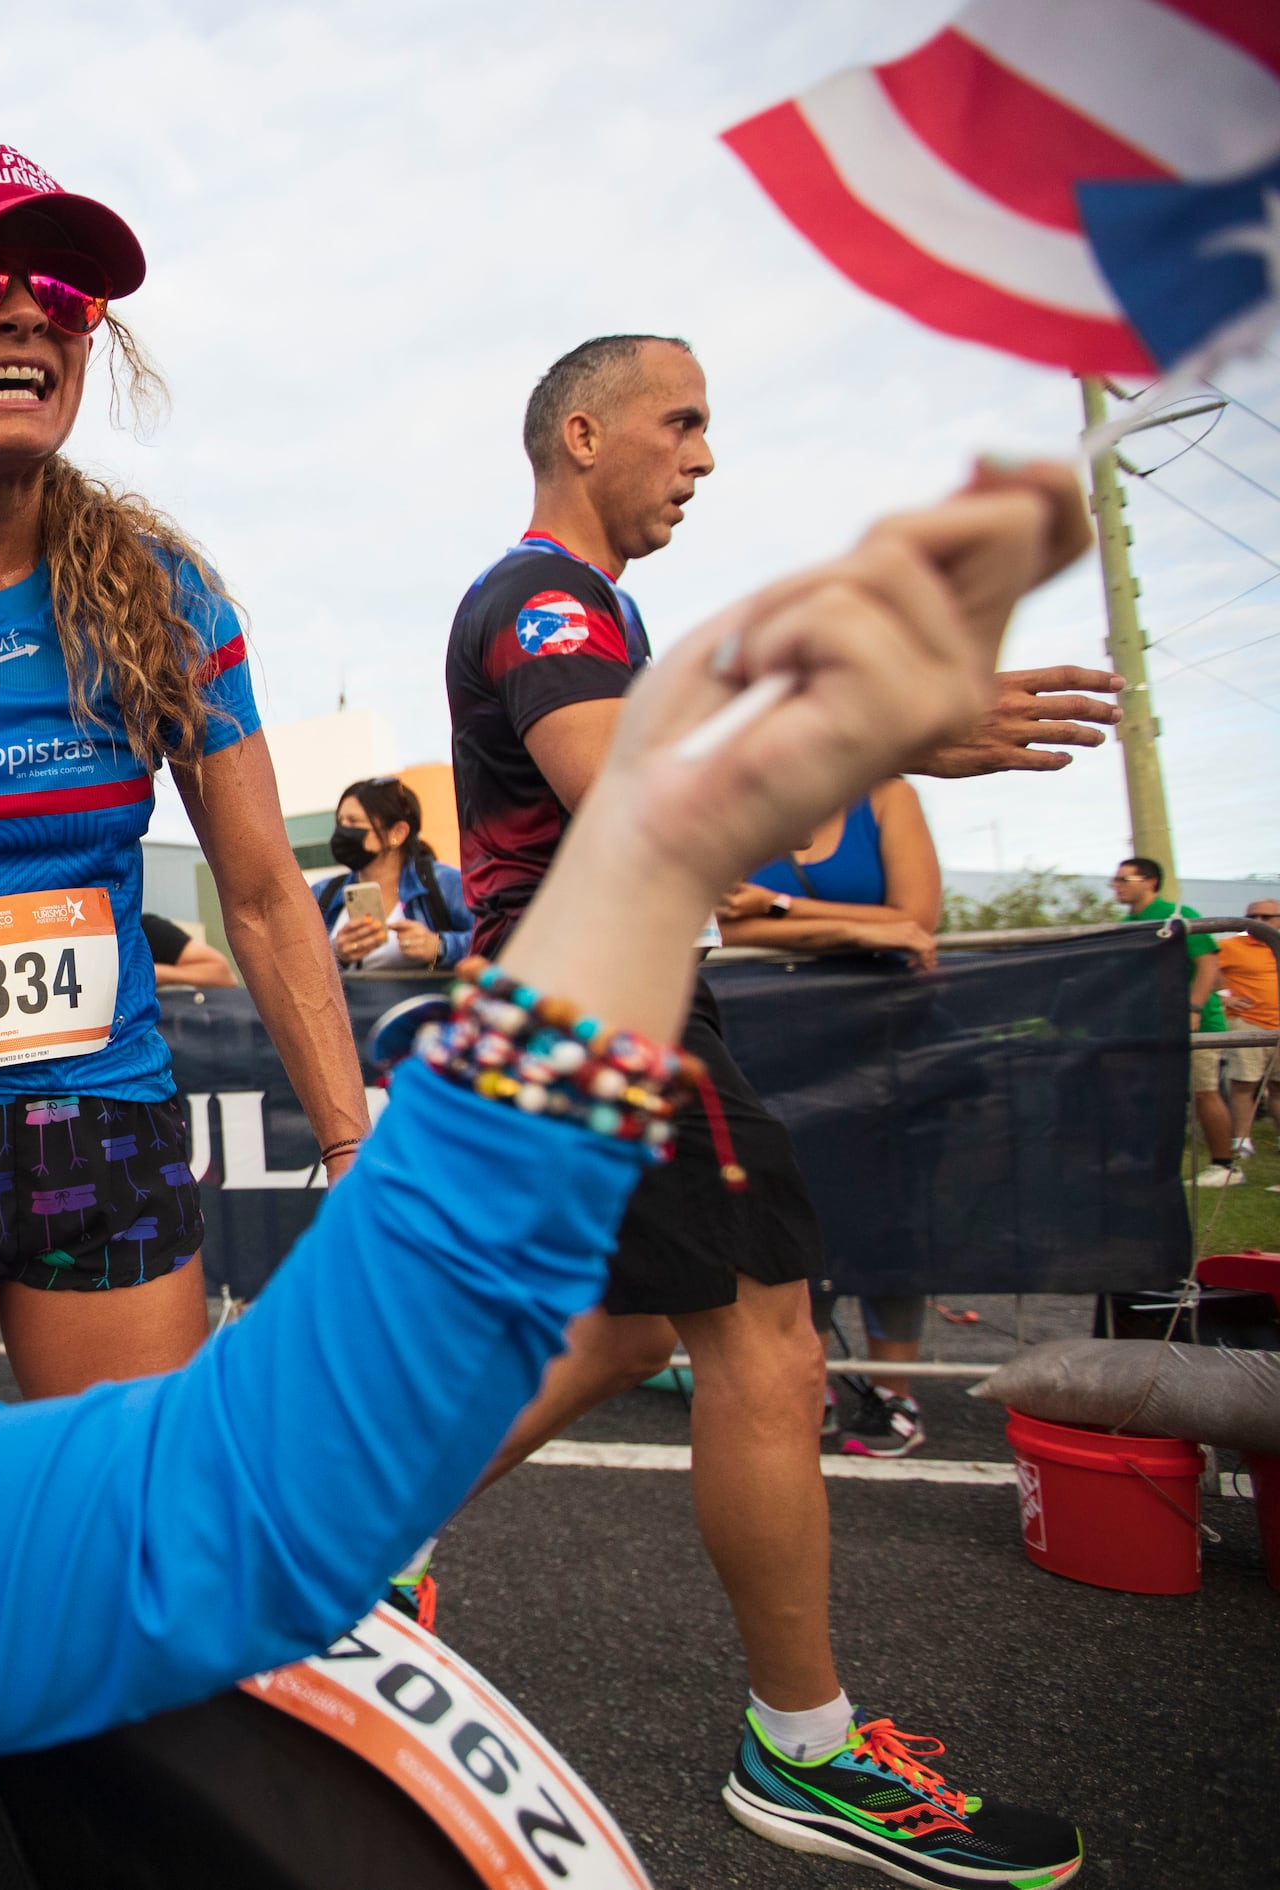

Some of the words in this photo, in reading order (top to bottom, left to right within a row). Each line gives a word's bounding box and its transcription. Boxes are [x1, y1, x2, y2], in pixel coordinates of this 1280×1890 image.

[29, 767, 58, 778] Abertis
[60, 764, 94, 775] company
[32, 909, 68, 919] TURISMO
